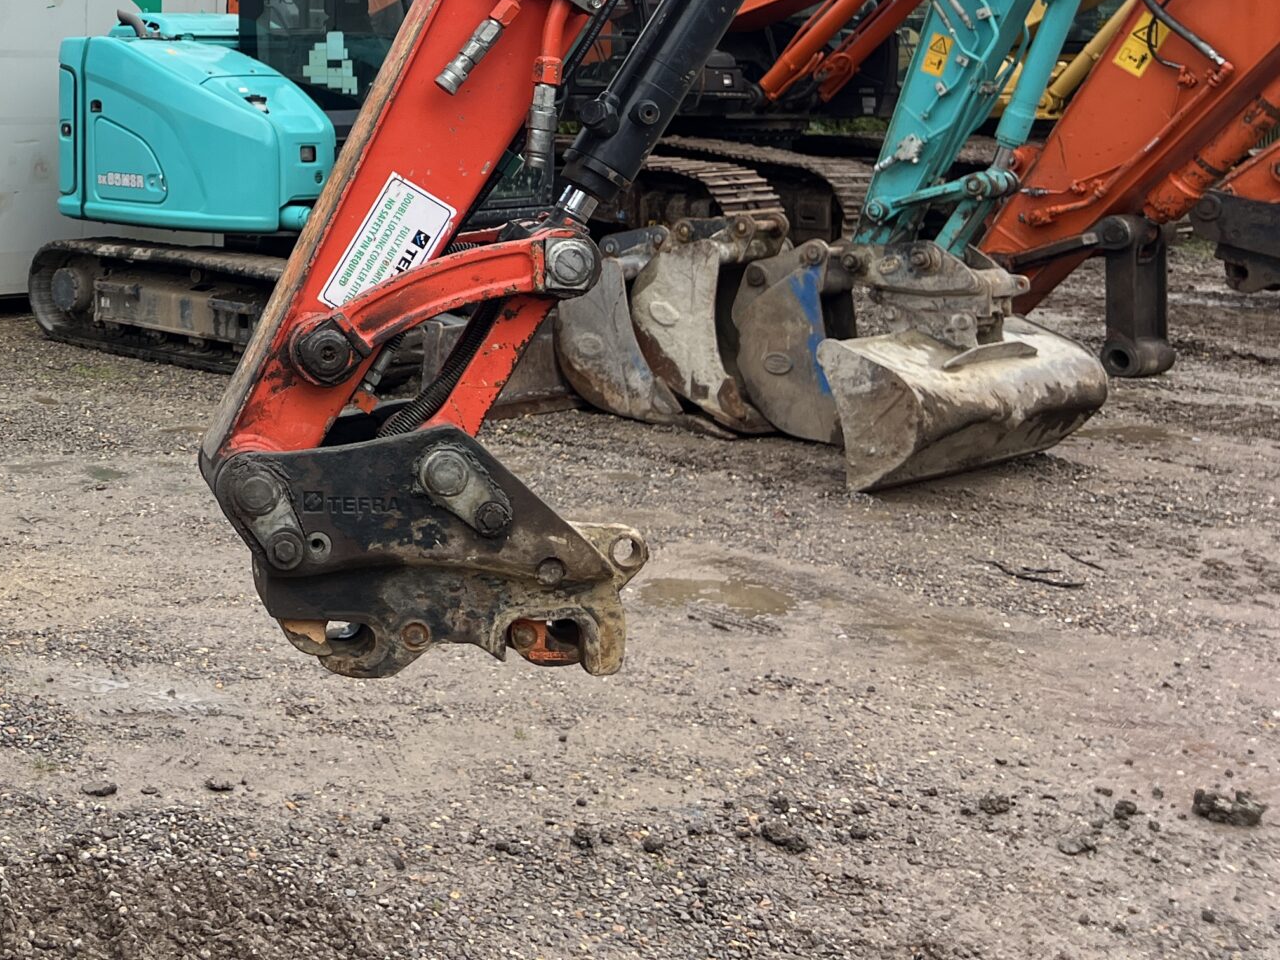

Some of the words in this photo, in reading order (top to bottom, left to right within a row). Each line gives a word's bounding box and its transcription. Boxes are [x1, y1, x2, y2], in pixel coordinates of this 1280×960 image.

[383, 197, 396, 211] NO
[392, 192, 415, 222] DOUBLE
[368, 208, 389, 237] SAFETY
[374, 220, 398, 252] LOCKING
[392, 225, 410, 249] FULLY
[360, 235, 373, 250] PIN
[337, 248, 365, 288] REQUIRED
[356, 249, 380, 283] COUPLER
